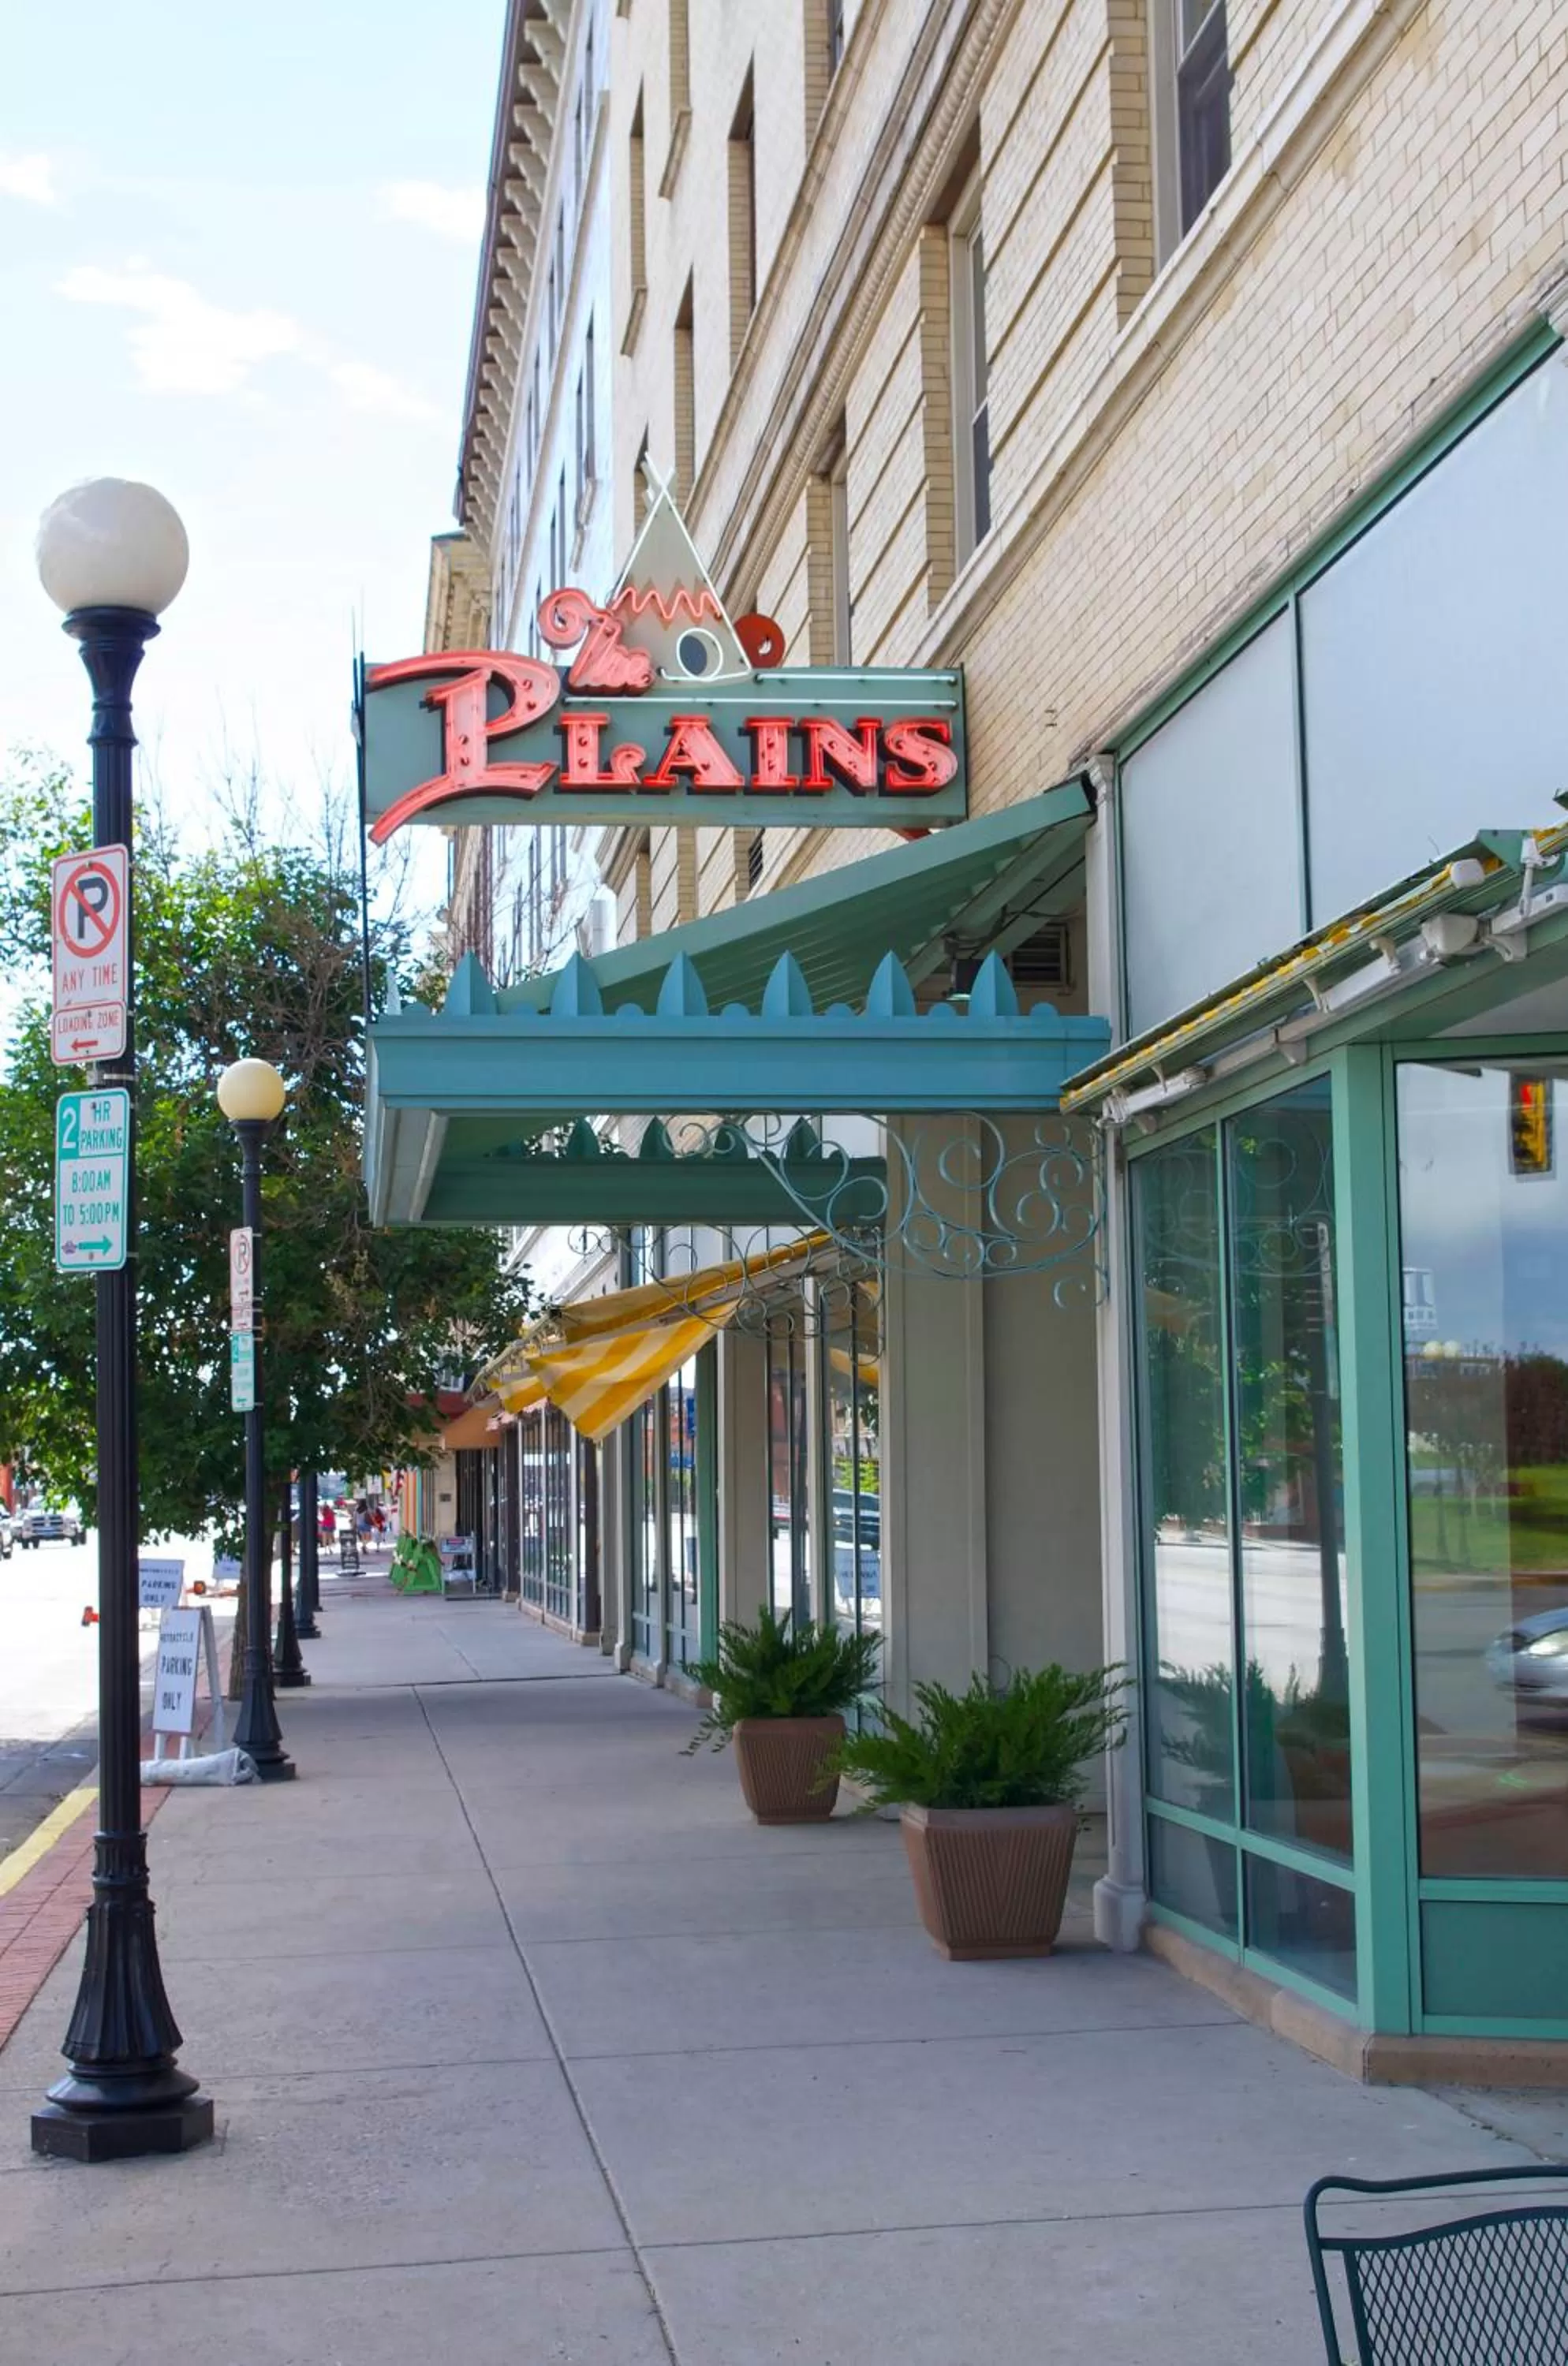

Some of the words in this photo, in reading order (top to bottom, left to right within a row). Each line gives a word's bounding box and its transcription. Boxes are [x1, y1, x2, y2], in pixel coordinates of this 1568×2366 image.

[368, 650, 958, 846] PLAINS
[62, 968, 84, 992] ANY
[93, 963, 118, 987] TIME
[58, 1014, 93, 1034] LOADING
[97, 1009, 118, 1029] ZONE
[62, 1106, 77, 1148] 2
[92, 1100, 111, 1122] HR
[81, 1126, 122, 1151] PARKING
[72, 1169, 111, 1193] 8:00AM
[63, 1203, 74, 1226] TO
[80, 1201, 119, 1225] 5:00PM
[141, 1580, 177, 1590] PARKING
[144, 1593, 166, 1603] ONLY
[161, 1655, 192, 1676] PARKING
[162, 1691, 181, 1711] ONLY
